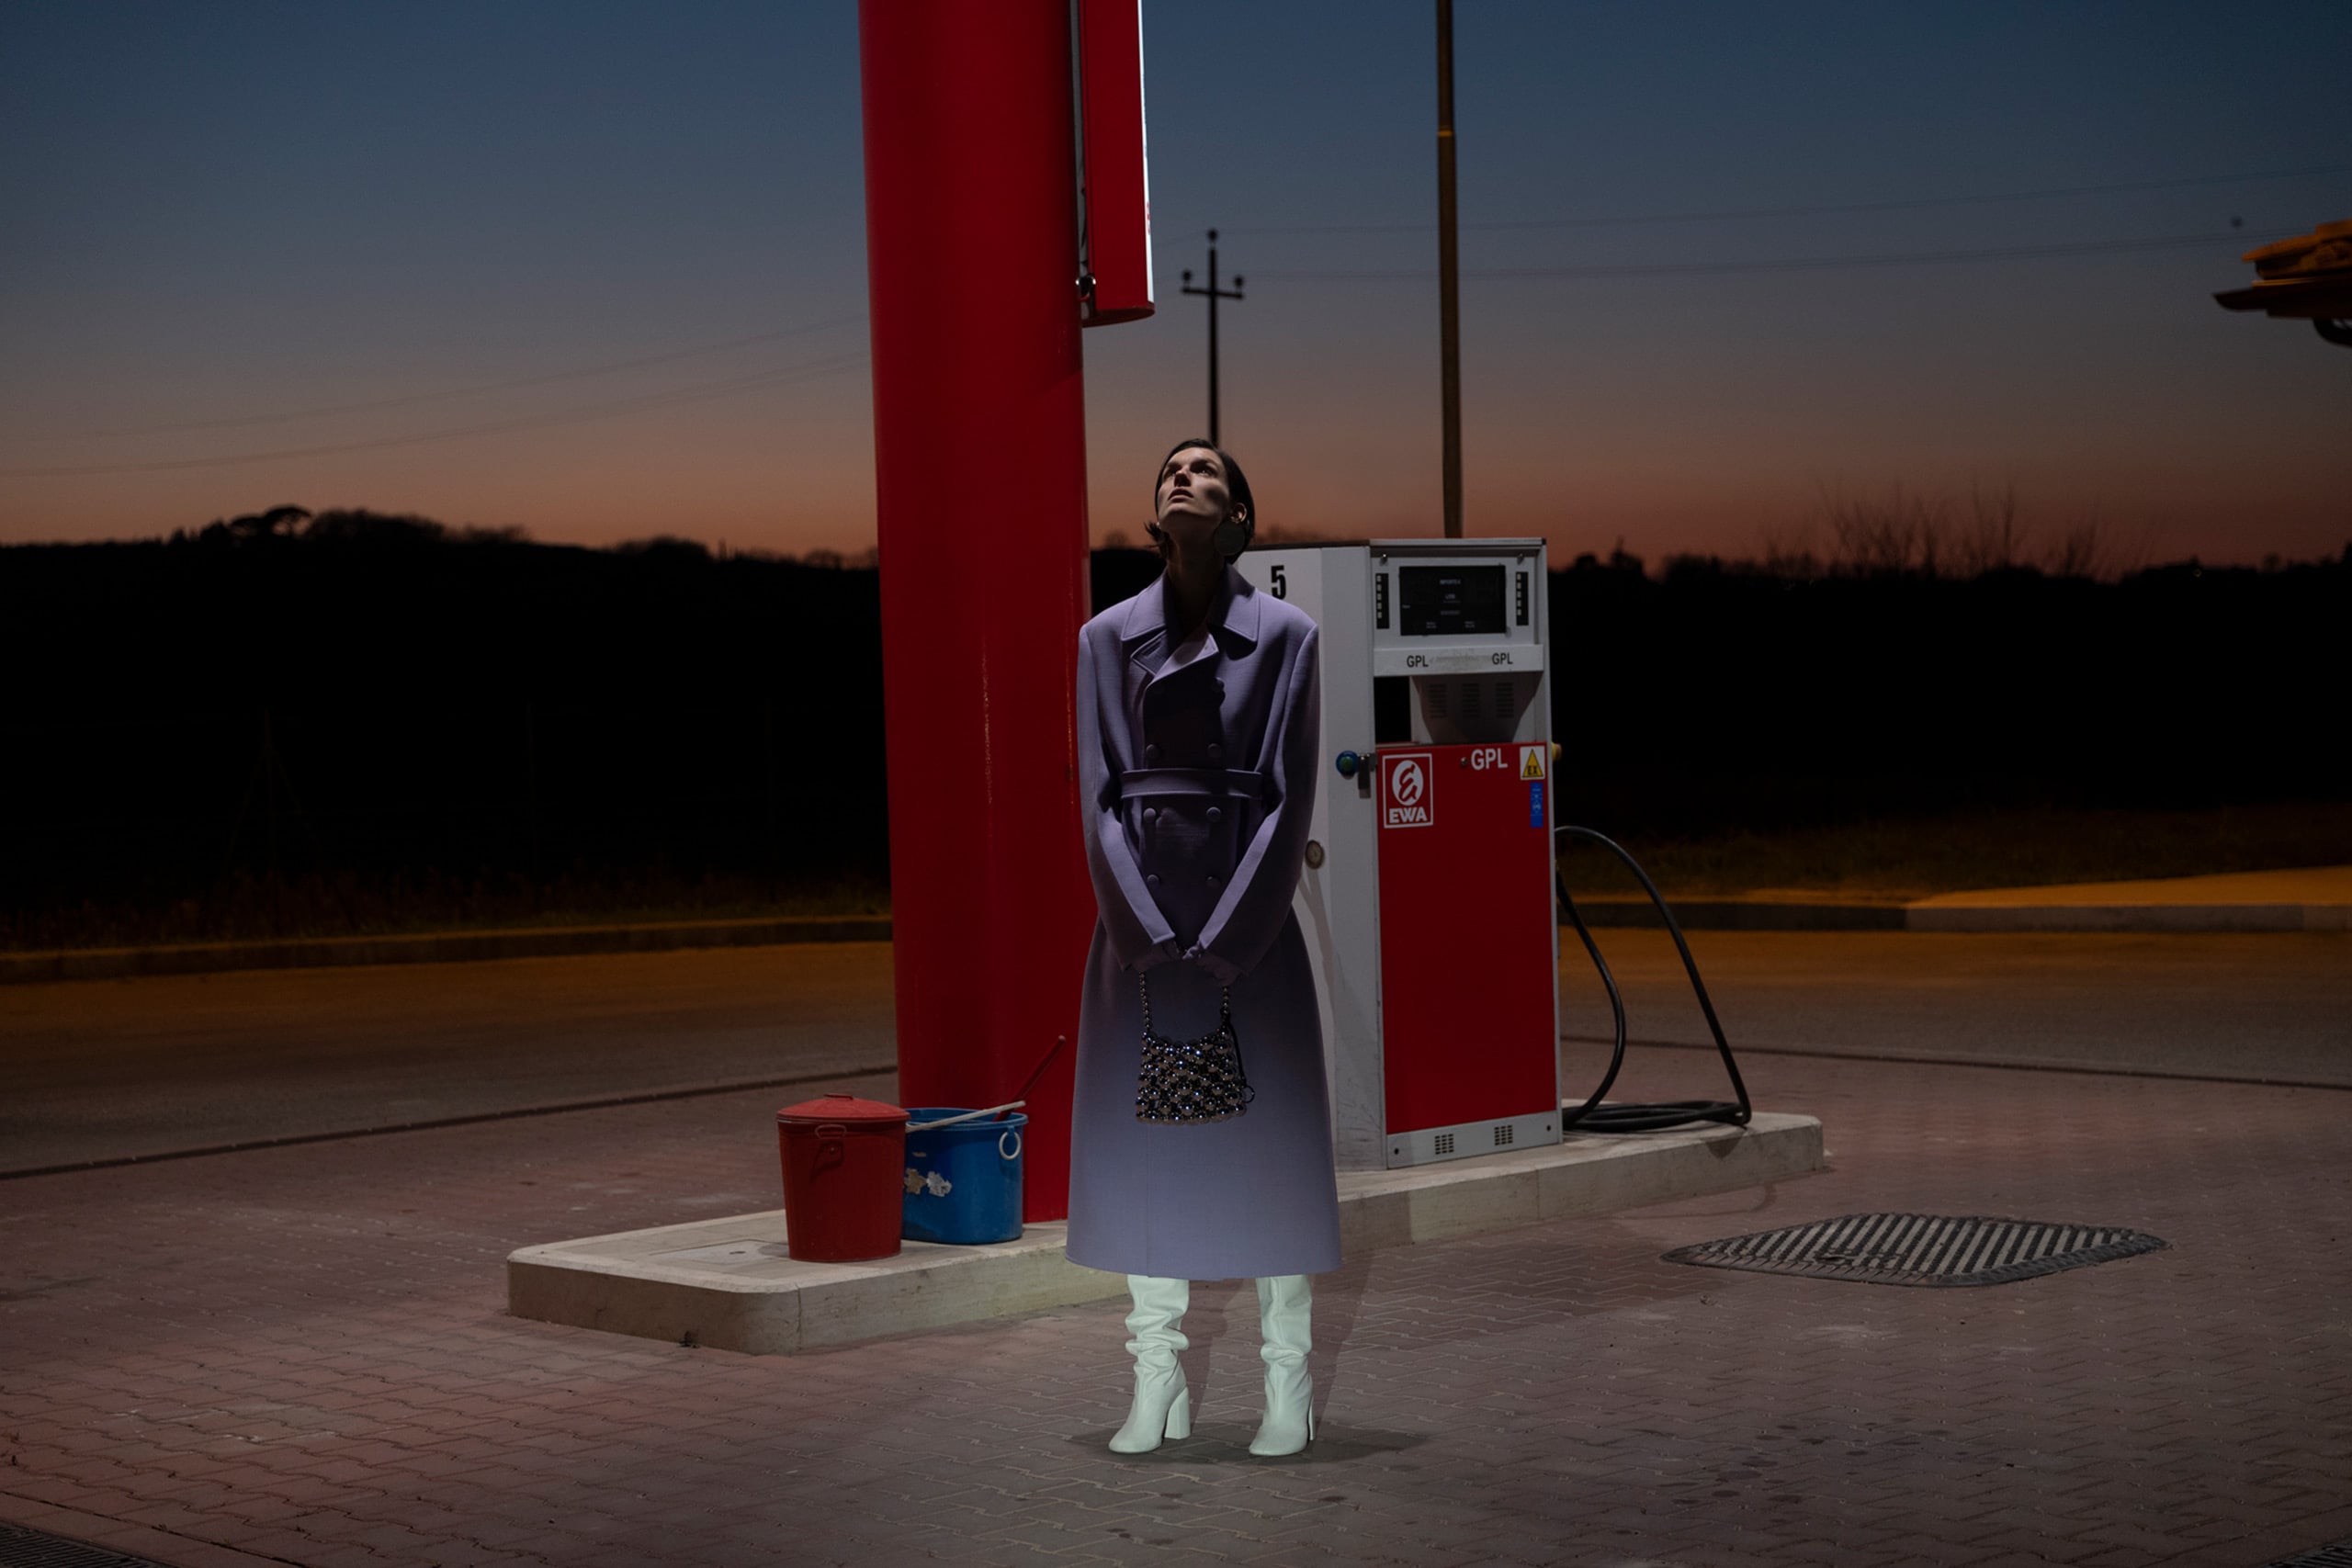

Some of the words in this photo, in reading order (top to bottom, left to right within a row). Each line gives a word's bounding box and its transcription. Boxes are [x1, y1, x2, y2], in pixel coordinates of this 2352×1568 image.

[1272, 565, 1286, 600] 5
[1406, 655, 1430, 668] GPL
[1492, 652, 1513, 665] GPL
[1471, 748, 1509, 771] GPL
[1389, 807, 1428, 823] EWA
